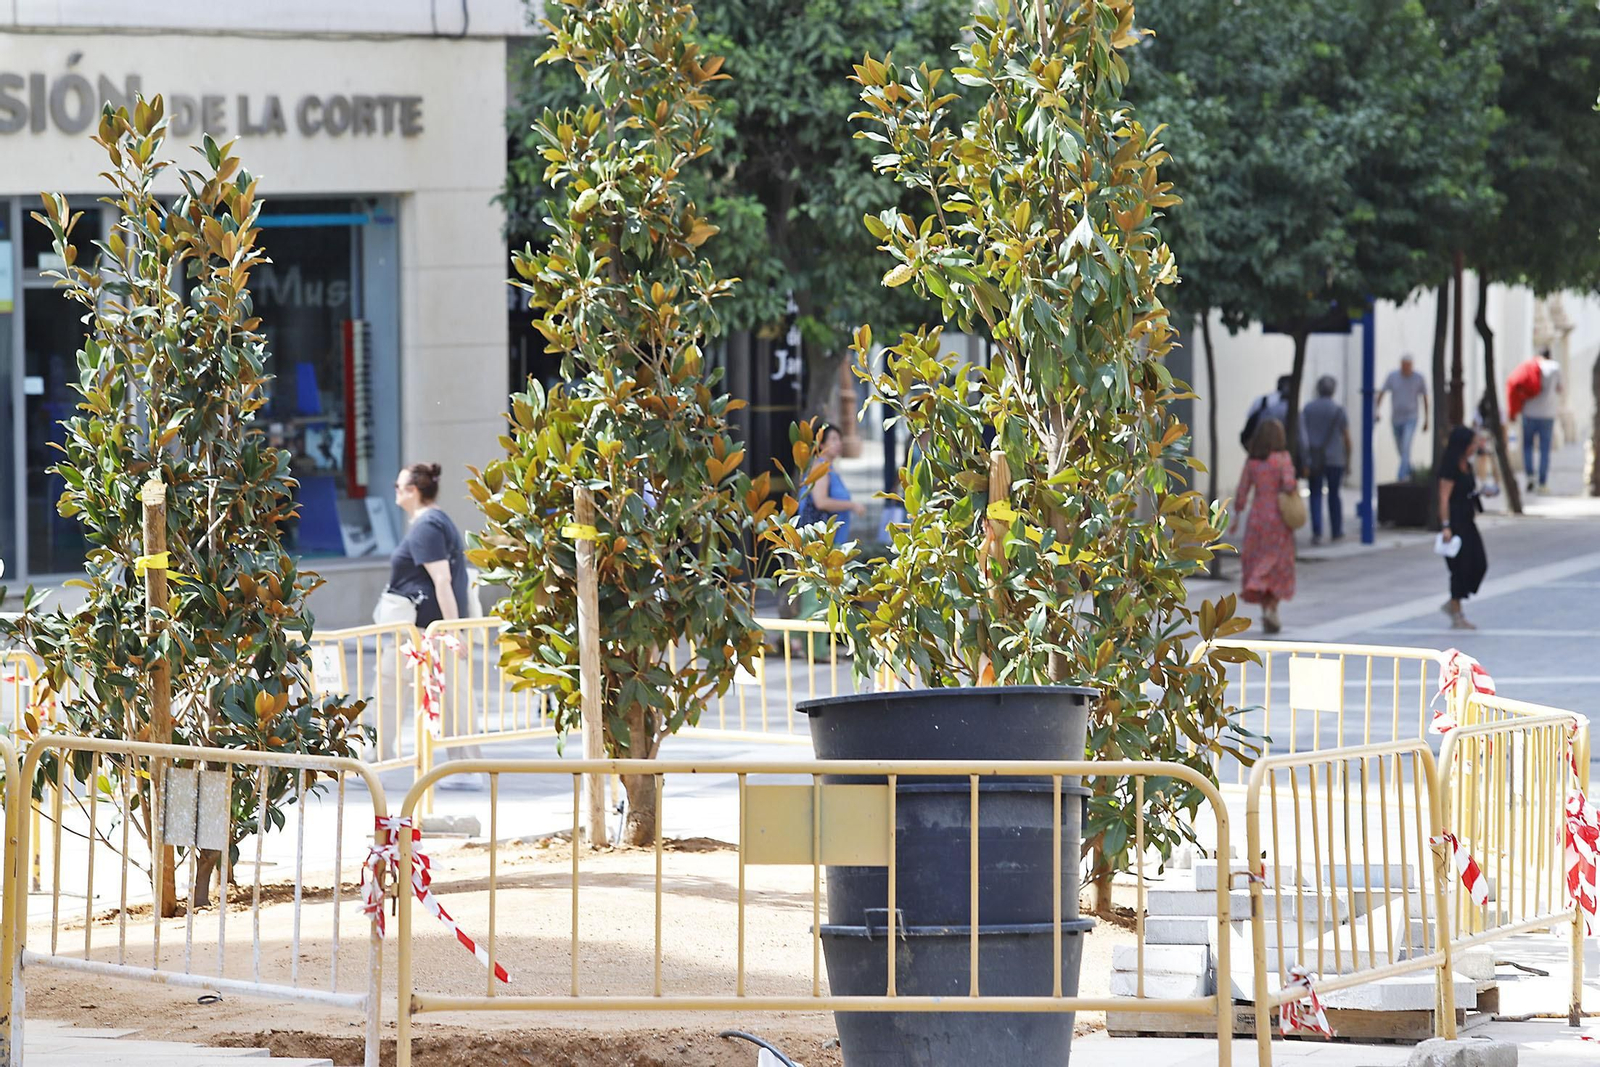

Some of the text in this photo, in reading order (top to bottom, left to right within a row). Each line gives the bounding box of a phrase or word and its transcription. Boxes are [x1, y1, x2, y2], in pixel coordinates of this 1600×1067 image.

[169, 94, 227, 138] DE
[237, 94, 287, 136] LA
[296, 93, 424, 138] CORTE
